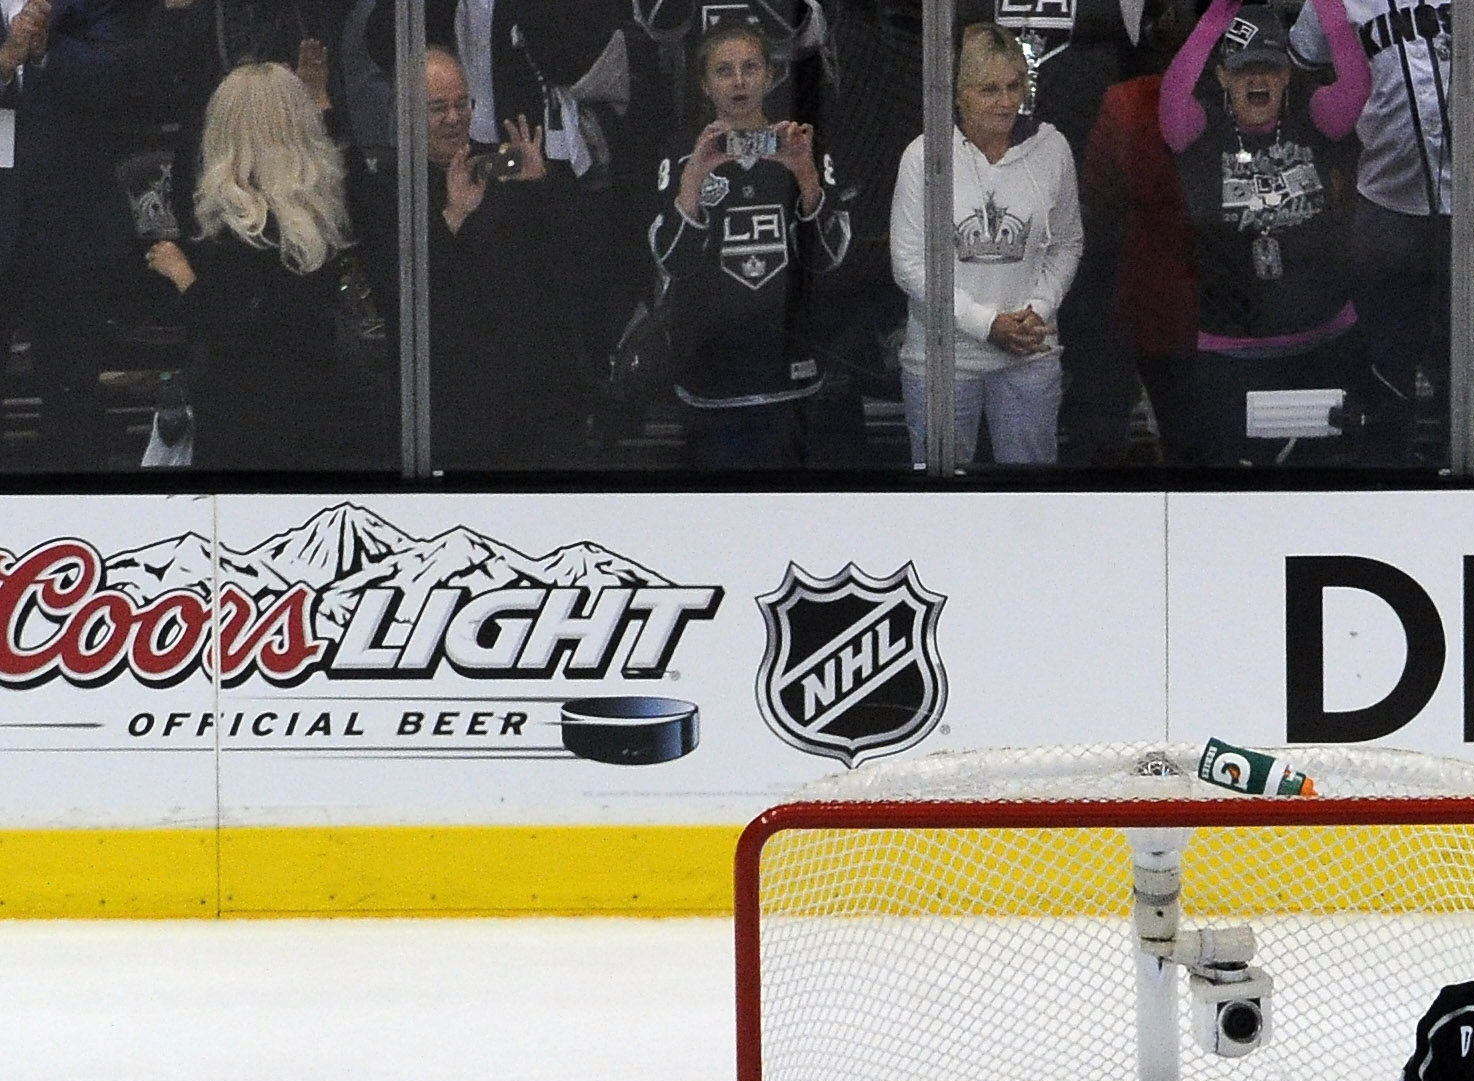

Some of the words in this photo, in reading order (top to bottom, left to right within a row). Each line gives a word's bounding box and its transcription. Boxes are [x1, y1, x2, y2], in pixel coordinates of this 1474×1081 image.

[657, 157, 671, 192] 8
[723, 213, 781, 242] LA
[0, 537, 328, 690] Coors
[324, 585, 724, 680] LIGHT
[800, 618, 907, 721] NHL
[128, 712, 366, 737] OFFICIAL
[396, 712, 530, 737] BEER
